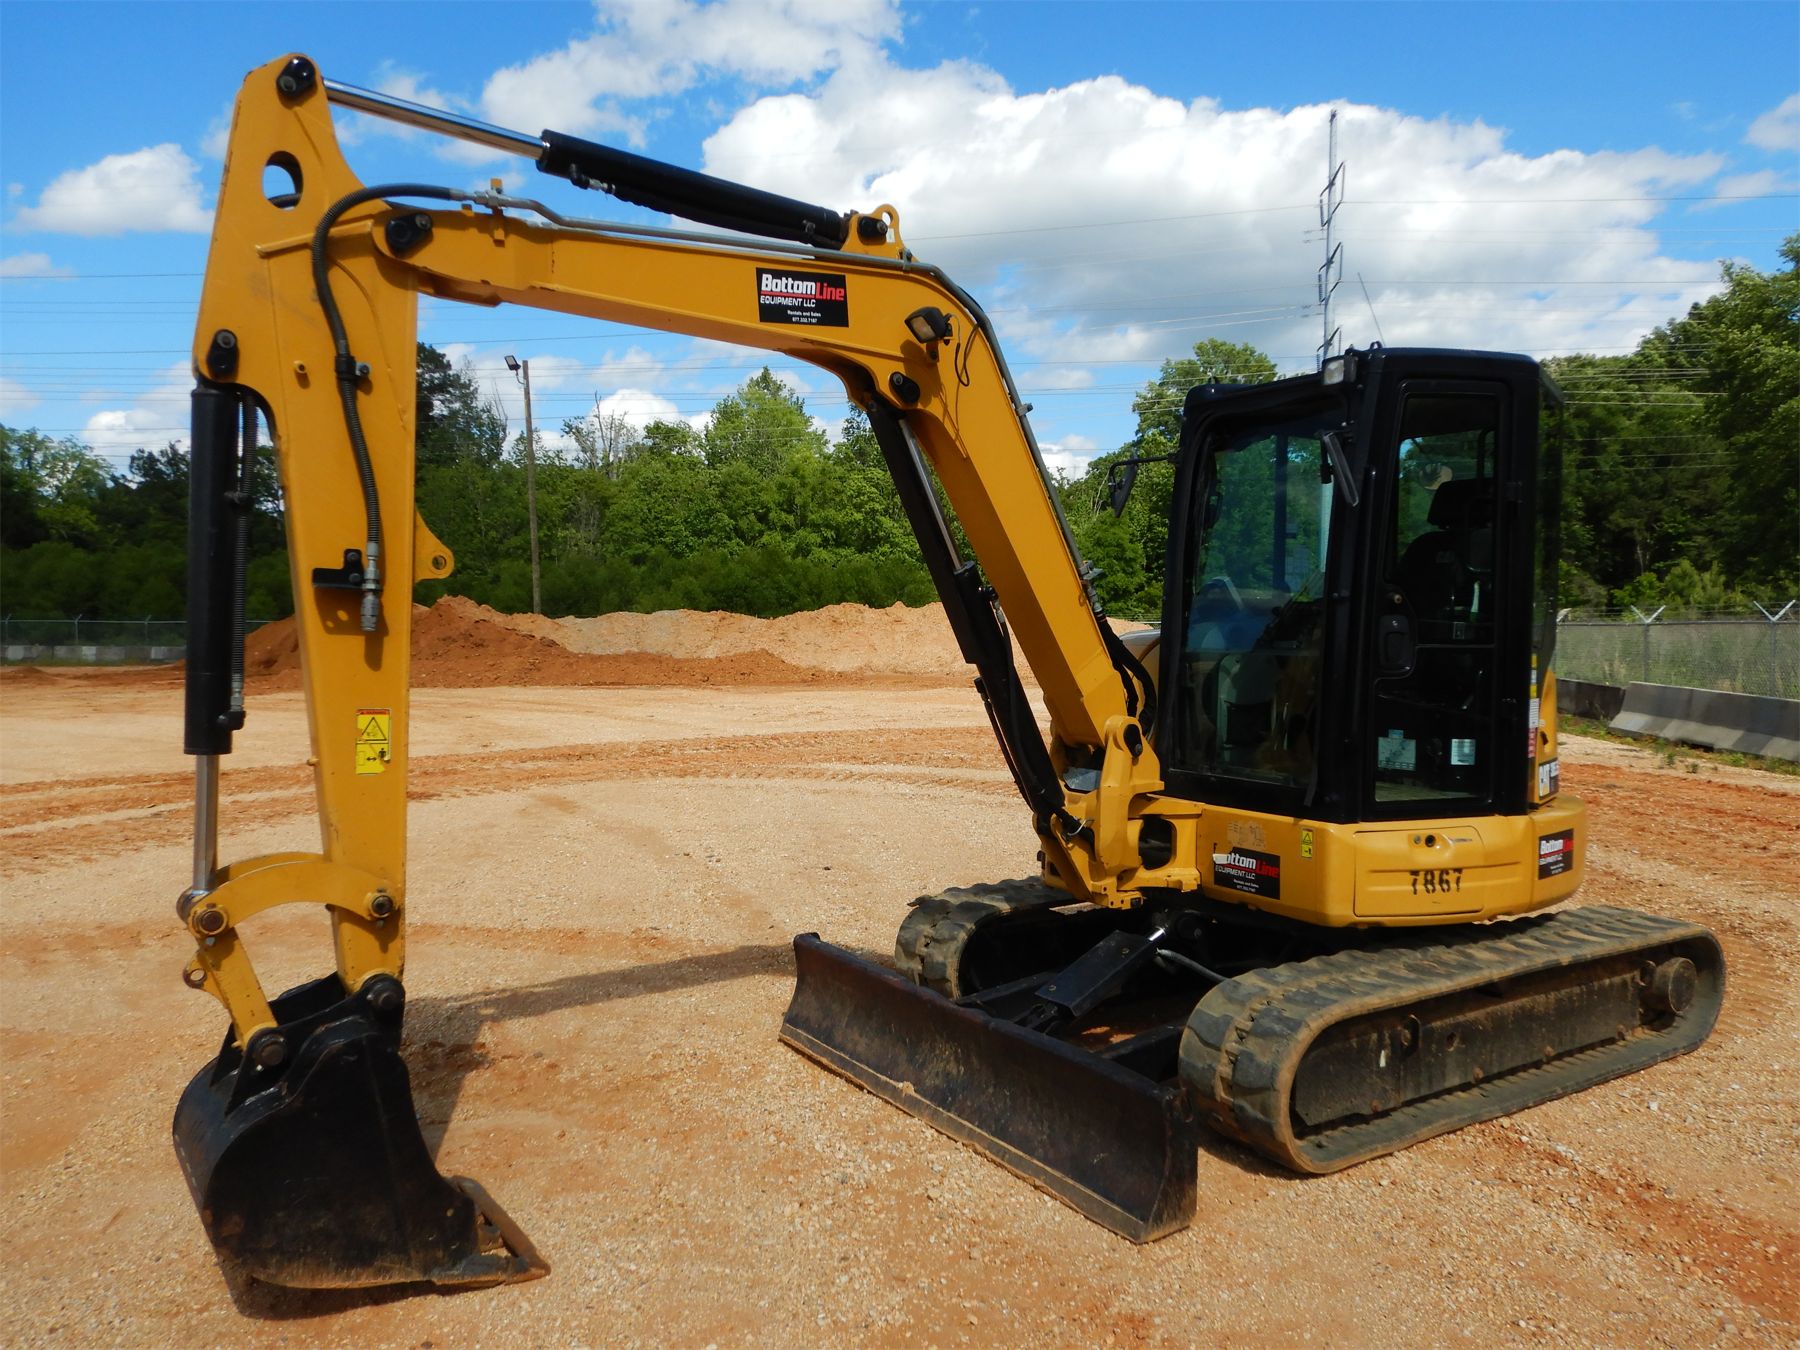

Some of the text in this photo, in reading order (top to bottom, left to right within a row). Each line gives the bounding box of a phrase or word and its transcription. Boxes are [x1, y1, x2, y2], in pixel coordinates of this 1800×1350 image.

[761, 273, 845, 301] BottomLine
[760, 295, 816, 308] EQUIPMENT LLC
[1409, 868, 1463, 895] 7867
